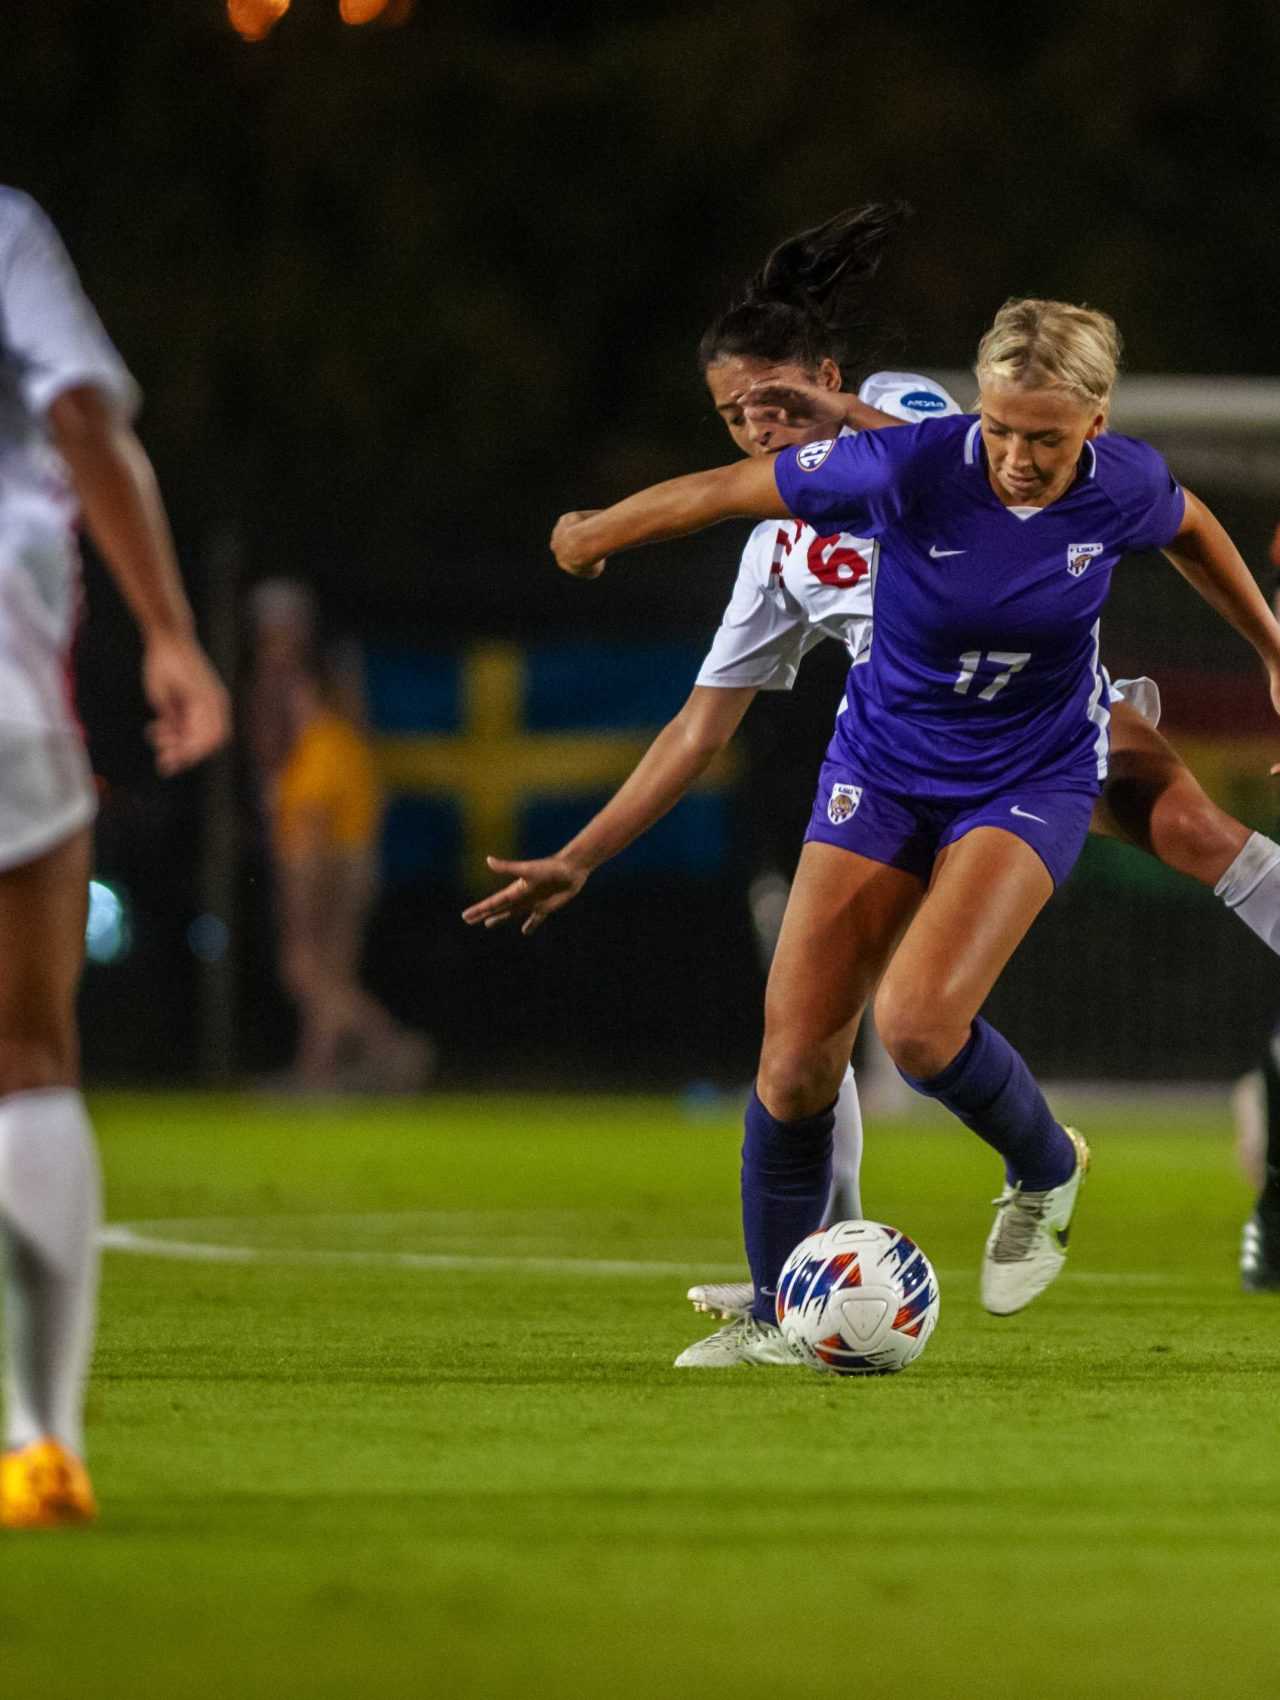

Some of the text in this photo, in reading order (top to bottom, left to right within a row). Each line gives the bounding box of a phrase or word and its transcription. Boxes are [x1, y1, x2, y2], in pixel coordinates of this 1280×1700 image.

[907, 399, 945, 409] NCAA
[807, 532, 869, 590] 6
[951, 650, 1032, 702] 17
